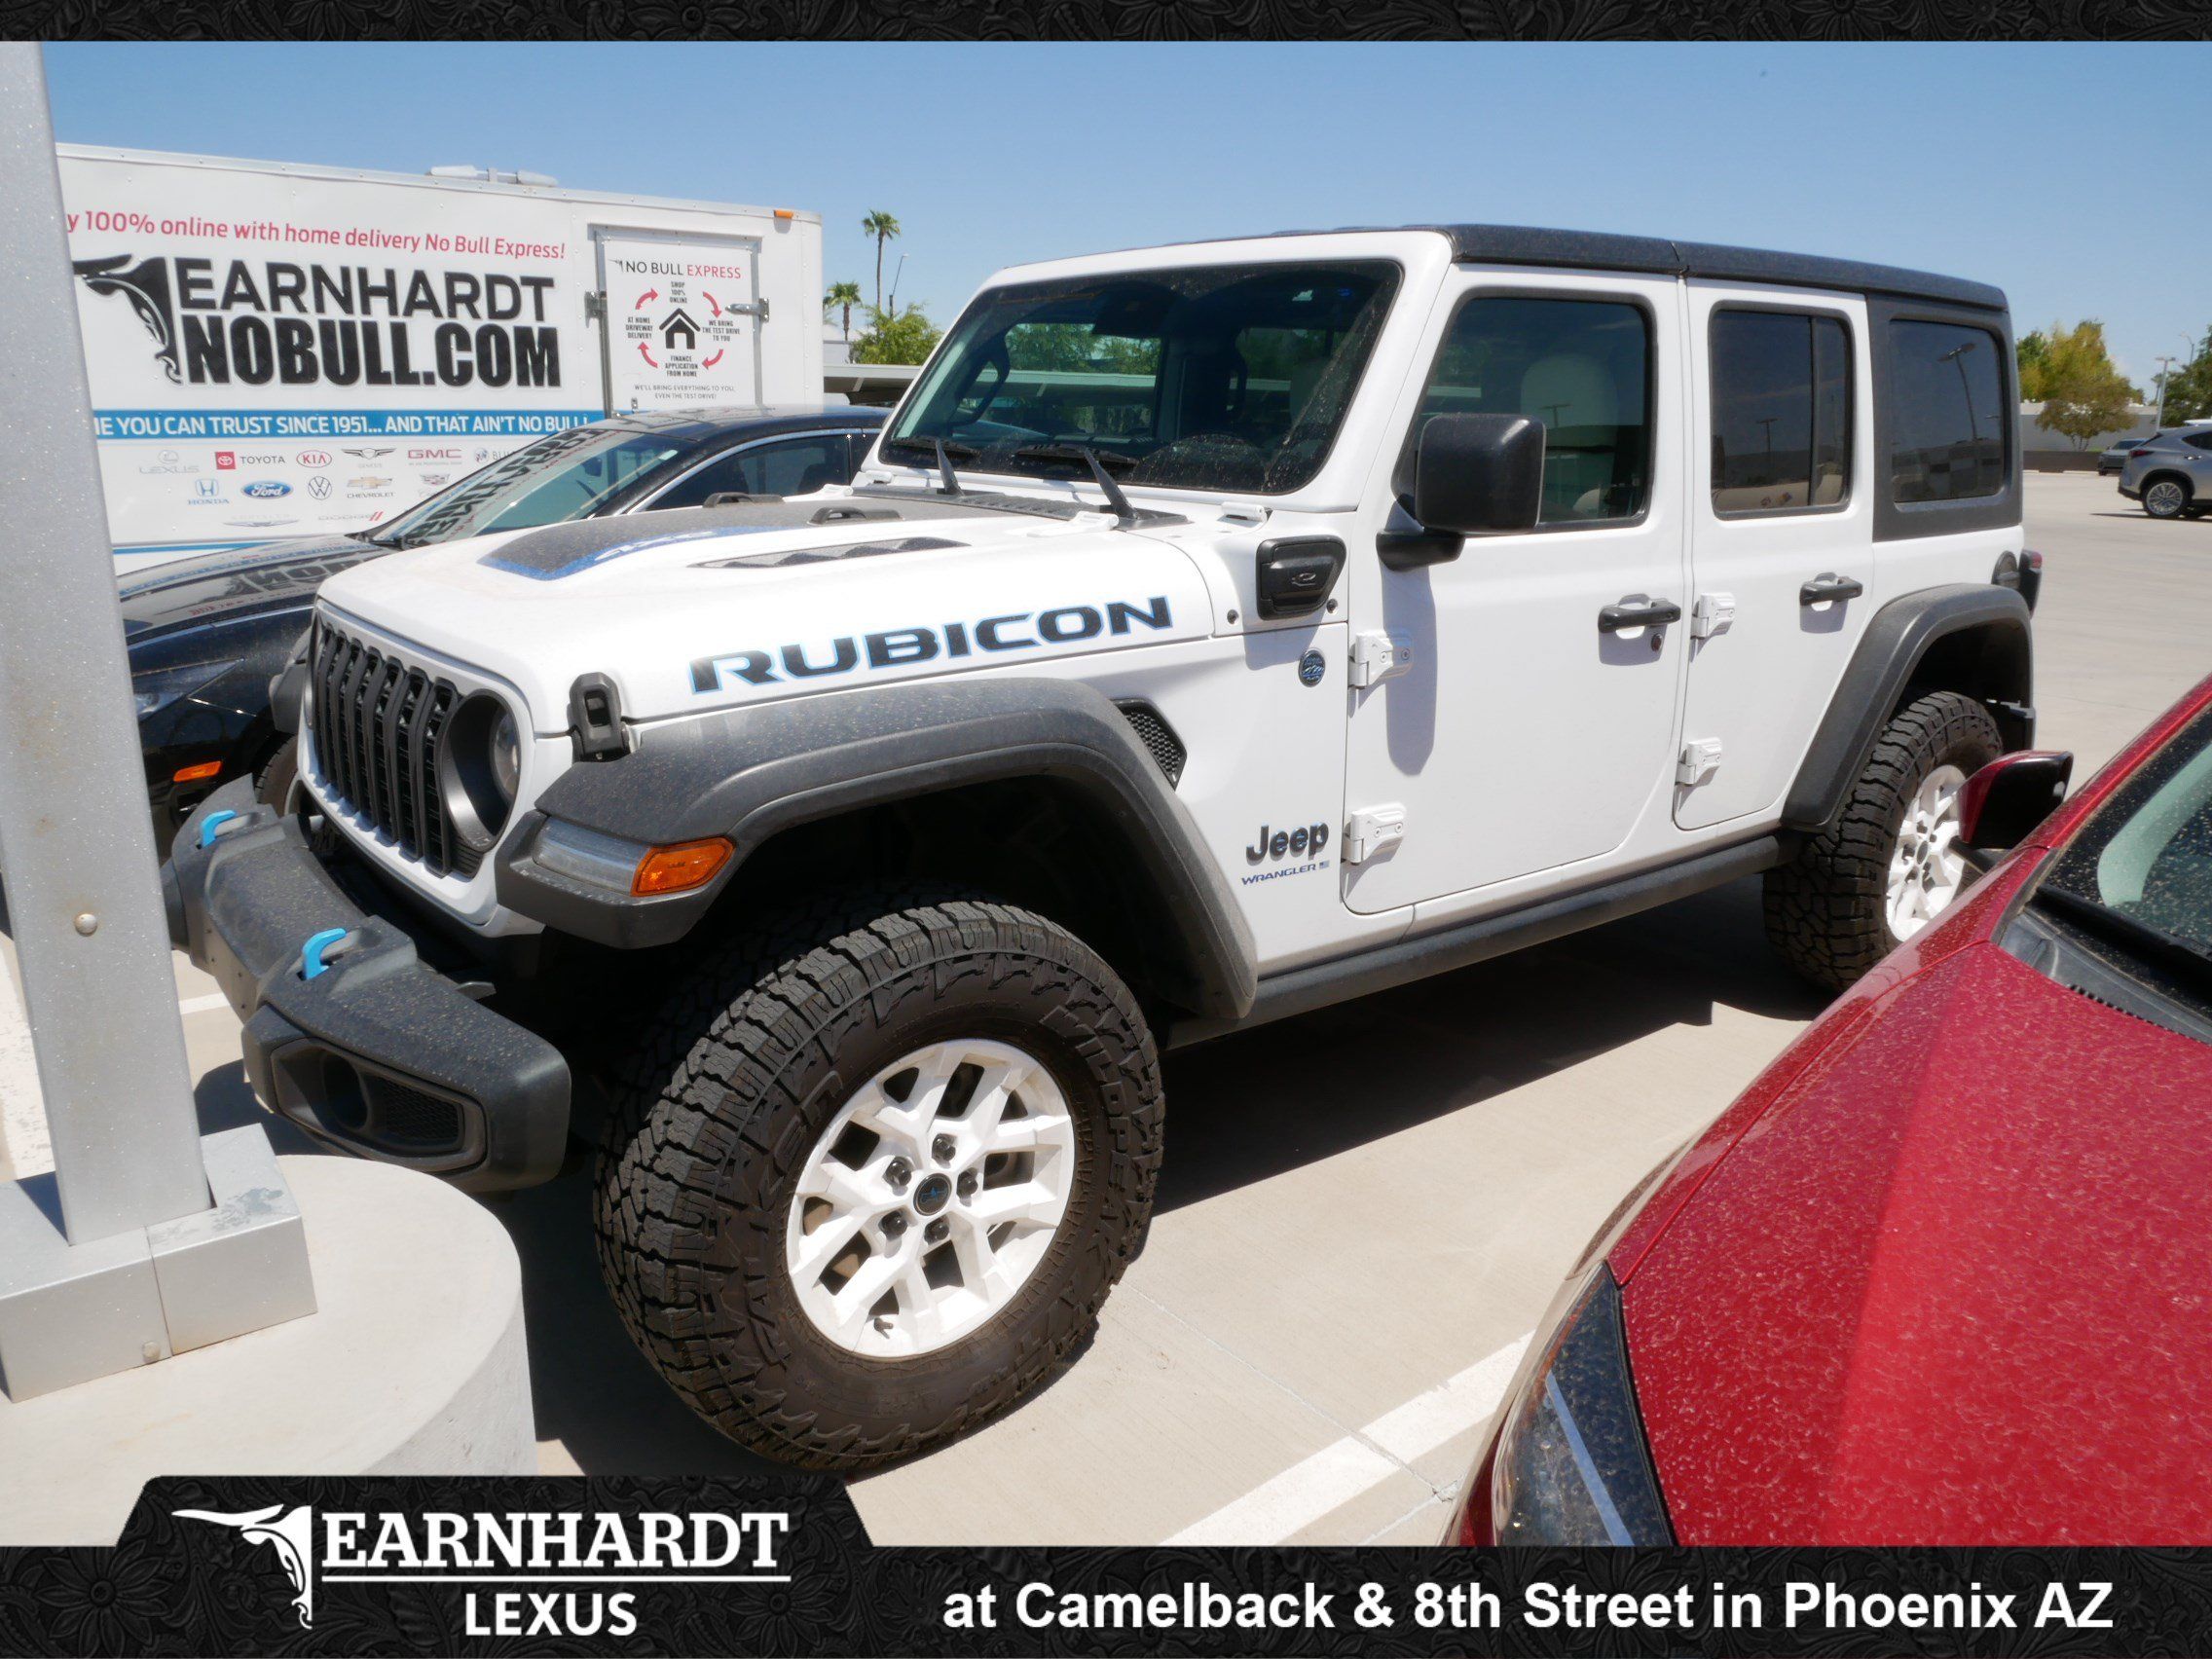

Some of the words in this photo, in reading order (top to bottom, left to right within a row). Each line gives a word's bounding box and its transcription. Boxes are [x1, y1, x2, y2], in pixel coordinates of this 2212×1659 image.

[86, 211, 155, 234] 100%
[161, 217, 228, 238] online
[234, 221, 279, 241] with
[285, 223, 340, 244] home
[345, 228, 421, 252] delivery
[424, 234, 450, 251] No
[455, 236, 490, 254] Bull
[495, 239, 565, 259] Express!
[626, 261, 647, 273] NO
[651, 262, 684, 276] BULL
[687, 264, 742, 279] EXPRESS
[174, 257, 554, 321] EARNHARDT
[182, 314, 561, 387] NOBULL.COM
[116, 417, 162, 435] YOU
[165, 417, 205, 435] CAN
[208, 417, 272, 434] TRUST
[276, 417, 328, 434] SINCE
[333, 416, 382, 433] 1951...
[386, 417, 422, 433] AND
[424, 416, 467, 433] THAT
[472, 416, 515, 432] AIN'T
[519, 416, 541, 432] NO
[240, 455, 285, 464] TOYOTA
[408, 449, 461, 459] GMC
[139, 465, 200, 474] LEXUS
[688, 596, 1172, 694] RUBICON
[1245, 822, 1329, 864] Jeep
[1241, 864, 1316, 885] WRANGLER
